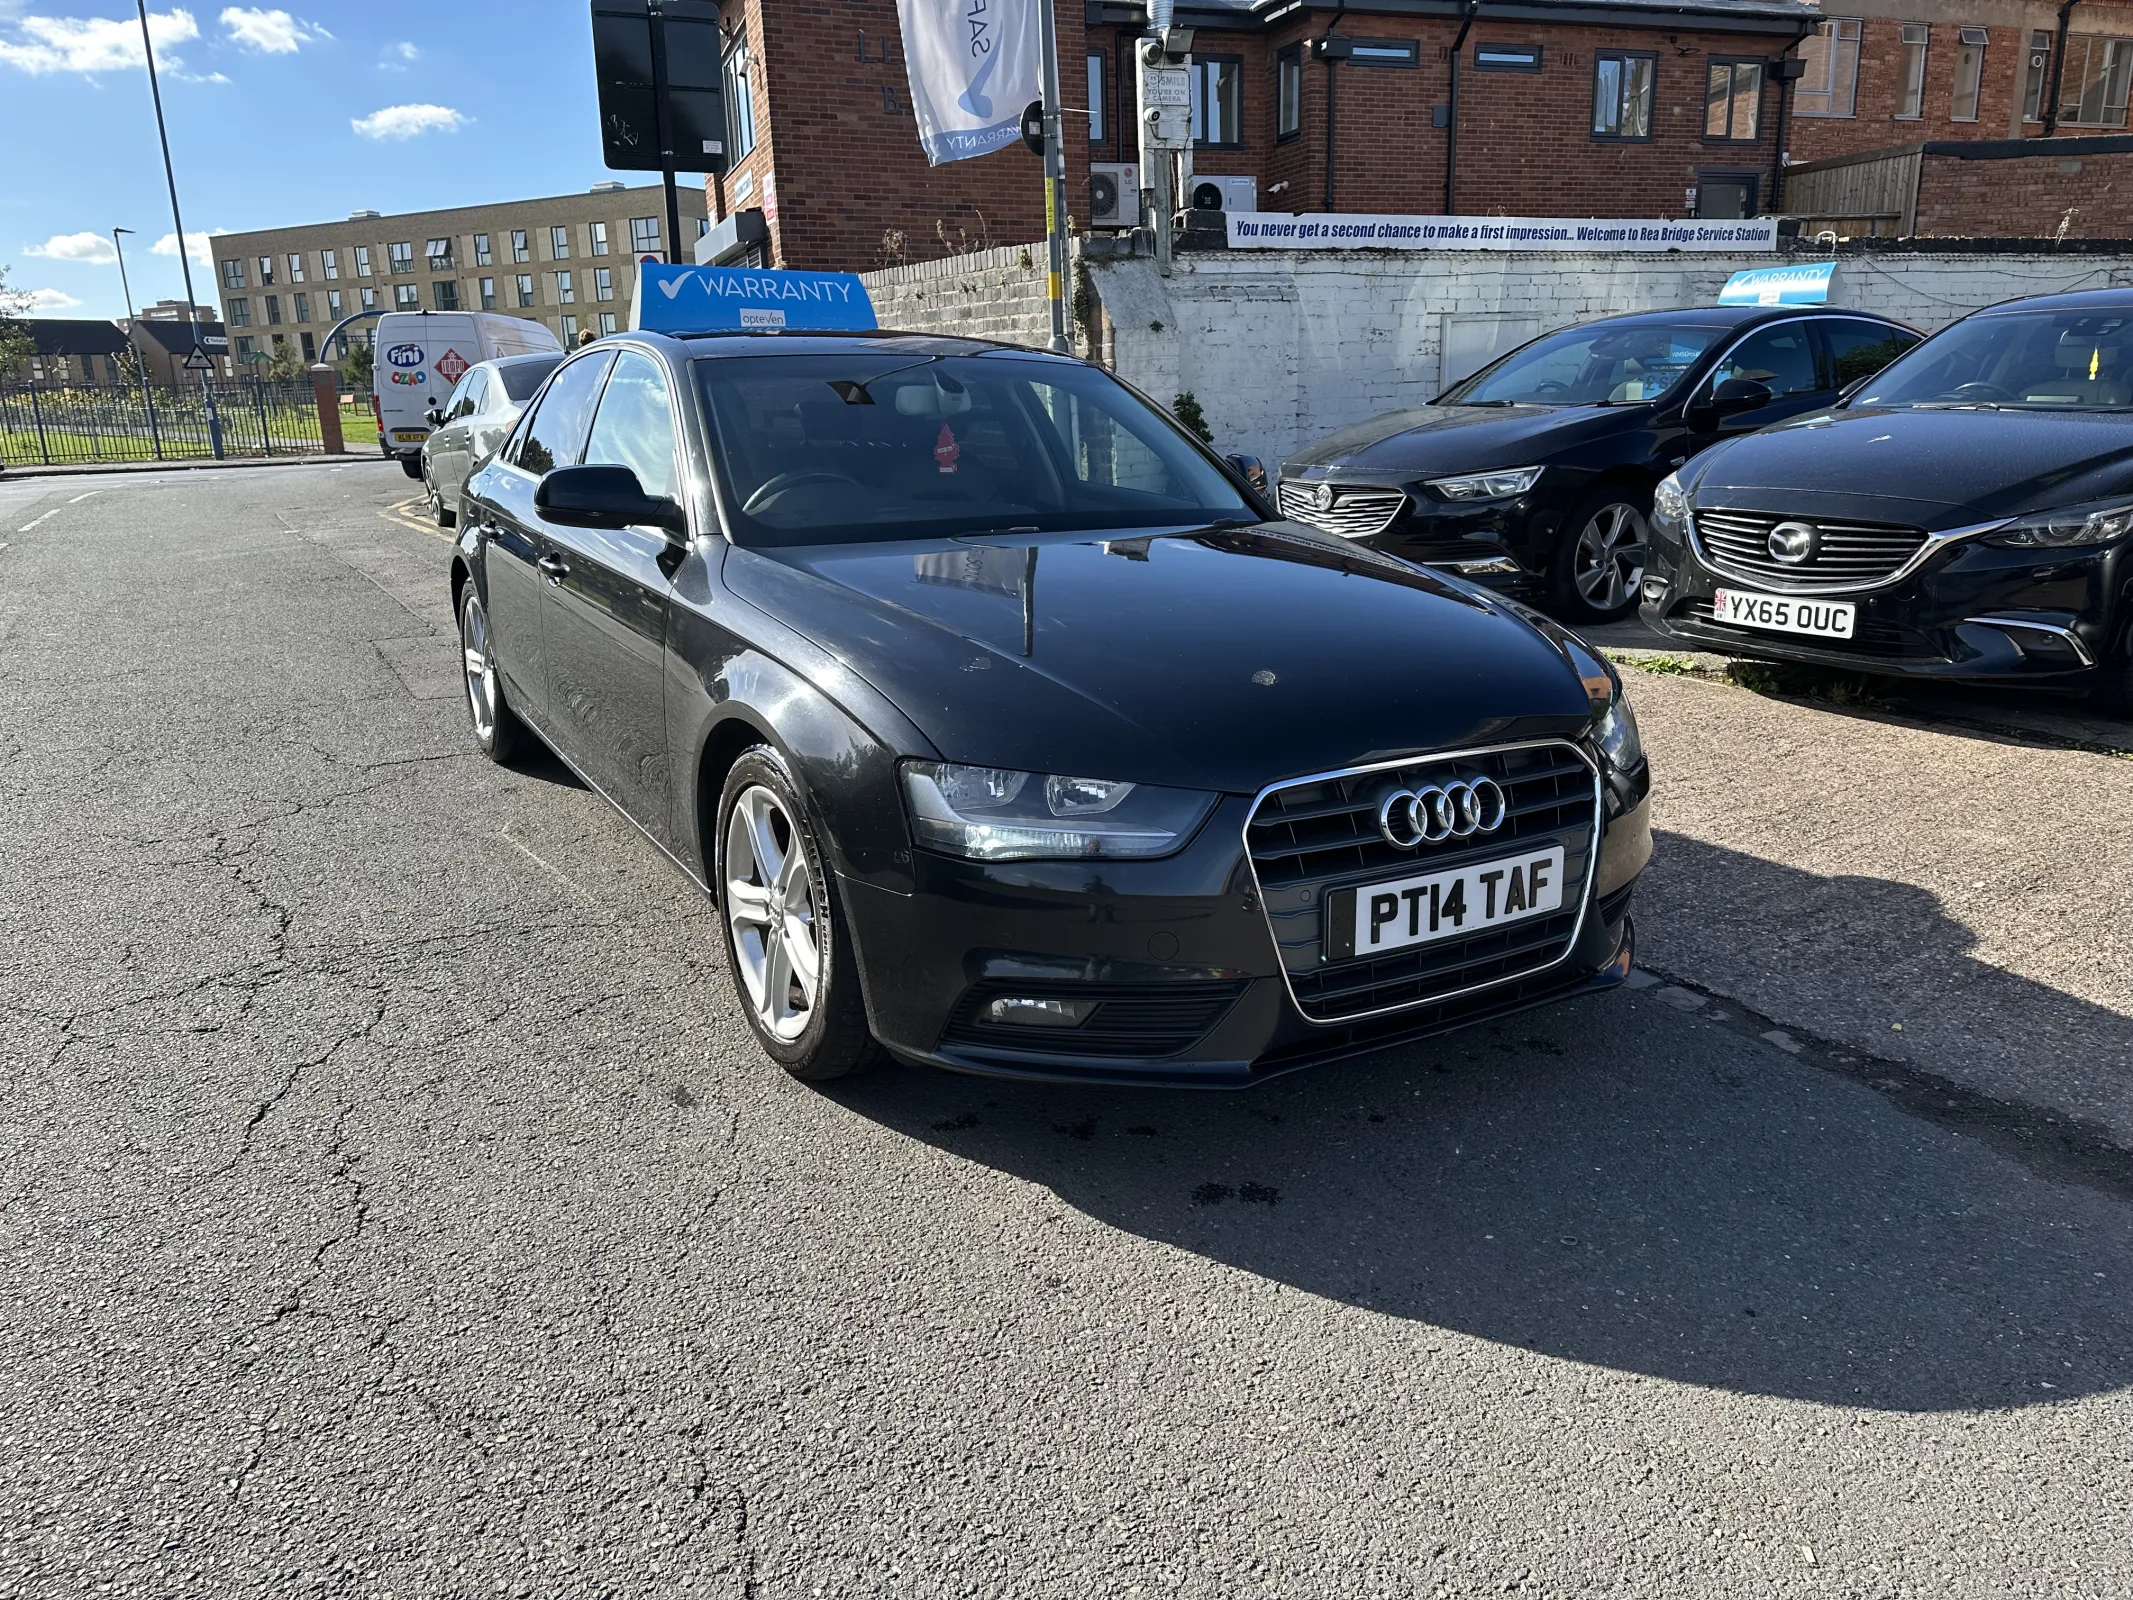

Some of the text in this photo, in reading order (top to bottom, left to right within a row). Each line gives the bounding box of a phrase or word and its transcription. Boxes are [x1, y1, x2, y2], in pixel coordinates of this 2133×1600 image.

[1161, 76, 1186, 86] SMILE
[1147, 88, 1172, 96] YOU'RE
[1236, 220, 1259, 236] You
[1260, 223, 1297, 237] never
[1298, 221, 1320, 239] get
[1321, 224, 1329, 237] a
[1331, 223, 1376, 238] second
[1377, 223, 1421, 238] chance
[1422, 224, 1436, 238] to
[1437, 224, 1469, 239] make
[1470, 226, 1478, 239] a
[1479, 225, 1505, 239] first
[1576, 226, 1626, 241] Welcome
[1627, 227, 1638, 241] to
[1640, 227, 1659, 241] Rea
[1660, 227, 1695, 242] Bridge
[1696, 227, 1733, 241] Service
[1735, 227, 1770, 241] Station
[1751, 268, 1828, 285] WARRANTY
[697, 275, 851, 303] WARRANTY
[742, 311, 784, 325] opteven
[390, 346, 420, 365] Fini
[1730, 596, 1848, 633] YX65 OUC
[1370, 858, 1553, 945] PT14 TAF
